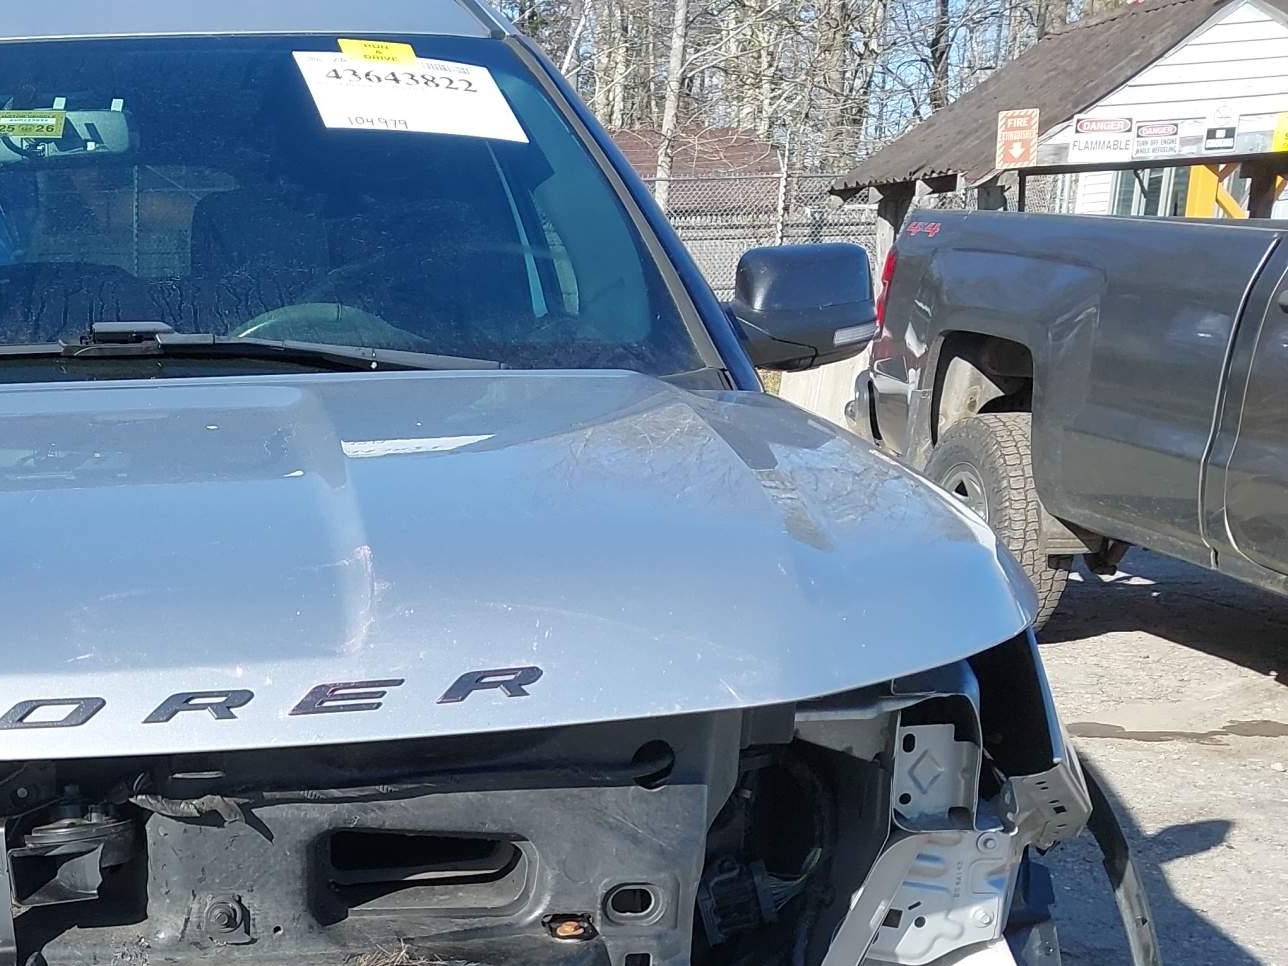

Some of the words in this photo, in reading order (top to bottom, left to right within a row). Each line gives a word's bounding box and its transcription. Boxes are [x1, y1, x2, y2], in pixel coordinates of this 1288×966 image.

[325, 68, 478, 93] 43643822
[1007, 118, 1029, 128] FIRE
[1083, 119, 1125, 130] DANGER
[35, 124, 55, 133] 26
[1142, 126, 1175, 136] DANGER
[1072, 140, 1131, 151] FLAMMABLE
